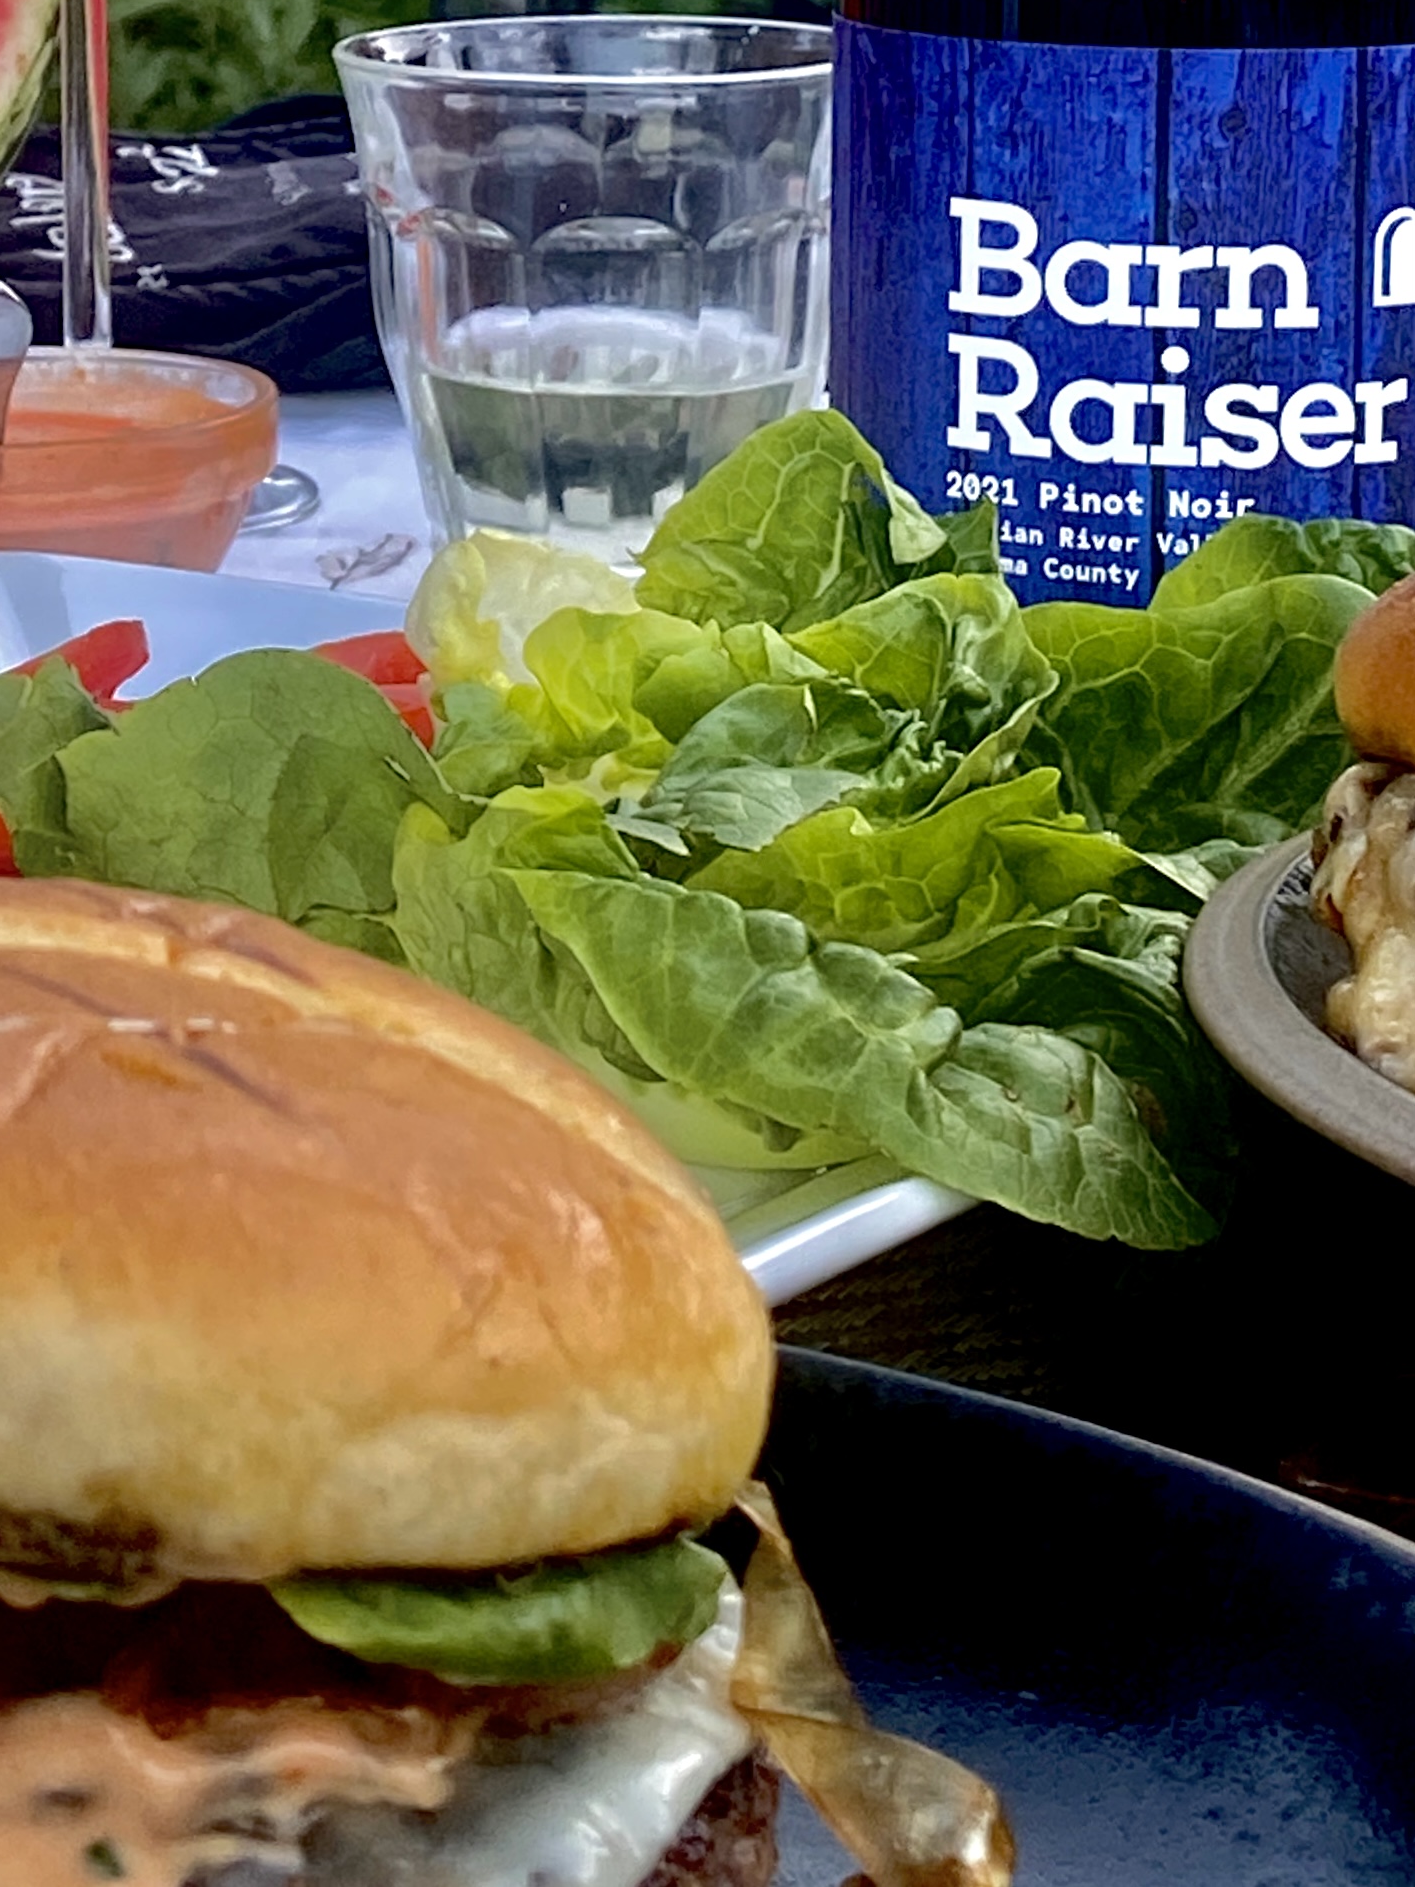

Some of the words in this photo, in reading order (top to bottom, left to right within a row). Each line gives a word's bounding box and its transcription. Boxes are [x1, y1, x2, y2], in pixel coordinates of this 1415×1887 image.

[948, 196, 1320, 329] Barn
[946, 332, 1409, 471] Raiser
[946, 469, 1019, 507] 2021
[1039, 481, 1145, 516] Pinot
[1168, 489, 1256, 519] Noir
[1059, 526, 1141, 553] River
[1043, 557, 1141, 592] County
